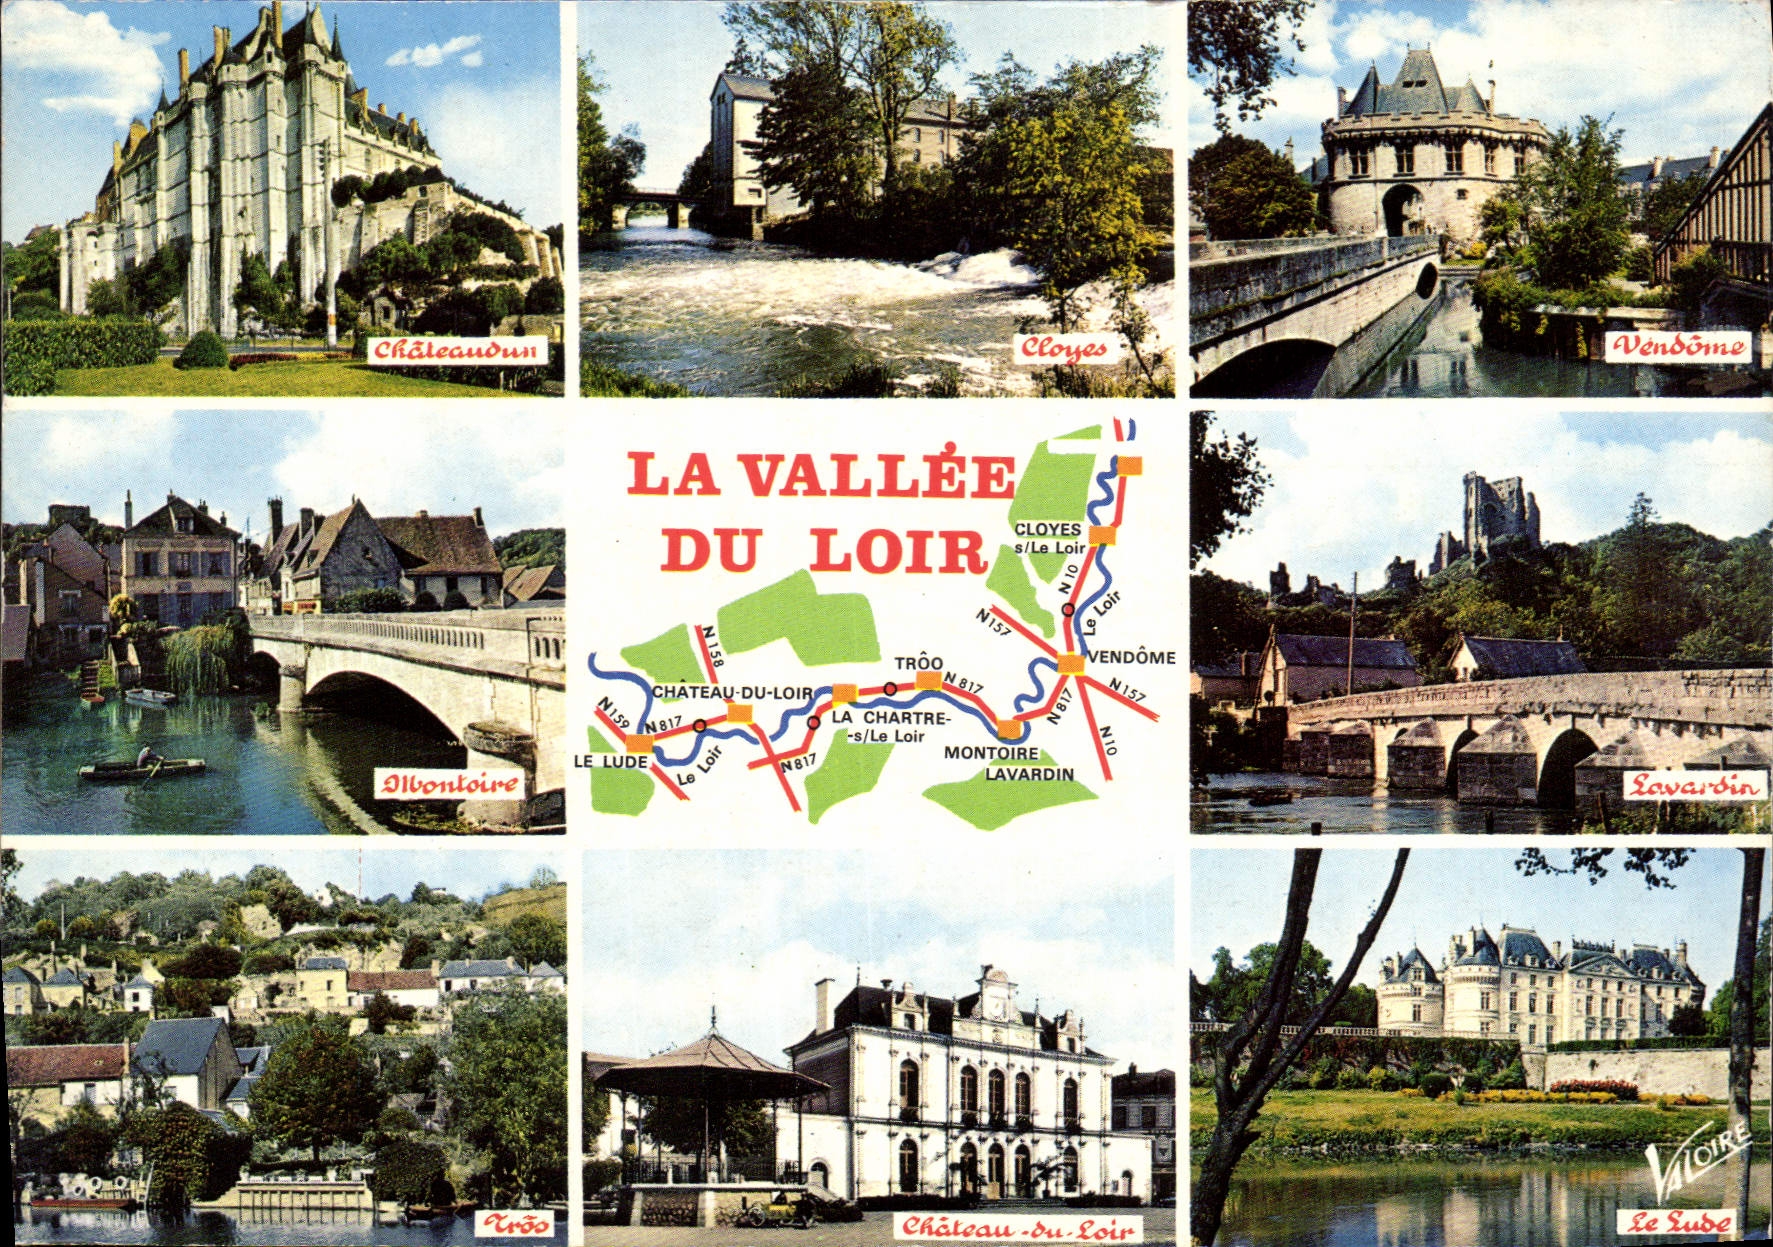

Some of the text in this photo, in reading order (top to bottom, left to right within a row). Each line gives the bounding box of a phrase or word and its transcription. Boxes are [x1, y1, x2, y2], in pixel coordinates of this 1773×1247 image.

[627, 441, 1015, 499] LA VALLÉE
[1014, 523, 1082, 537] CLOYES
[660, 527, 989, 575] DU LOIR
[1014, 541, 1086, 555] s/Le Loir
[1083, 590, 1121, 636] Le Loir
[894, 650, 944, 670] TRÔO
[1086, 645, 1177, 665] VENDÔME
[652, 679, 813, 701] CHÂTEAU-DU-LOIR
[831, 710, 952, 726] LA CHARTRE-
[847, 729, 925, 743] -s/Le Loir
[574, 755, 648, 769] LE LUDE
[944, 746, 1038, 761] MONTOIRE
[677, 744, 722, 786] Le Loir
[985, 767, 1074, 782] LAVARDIN
